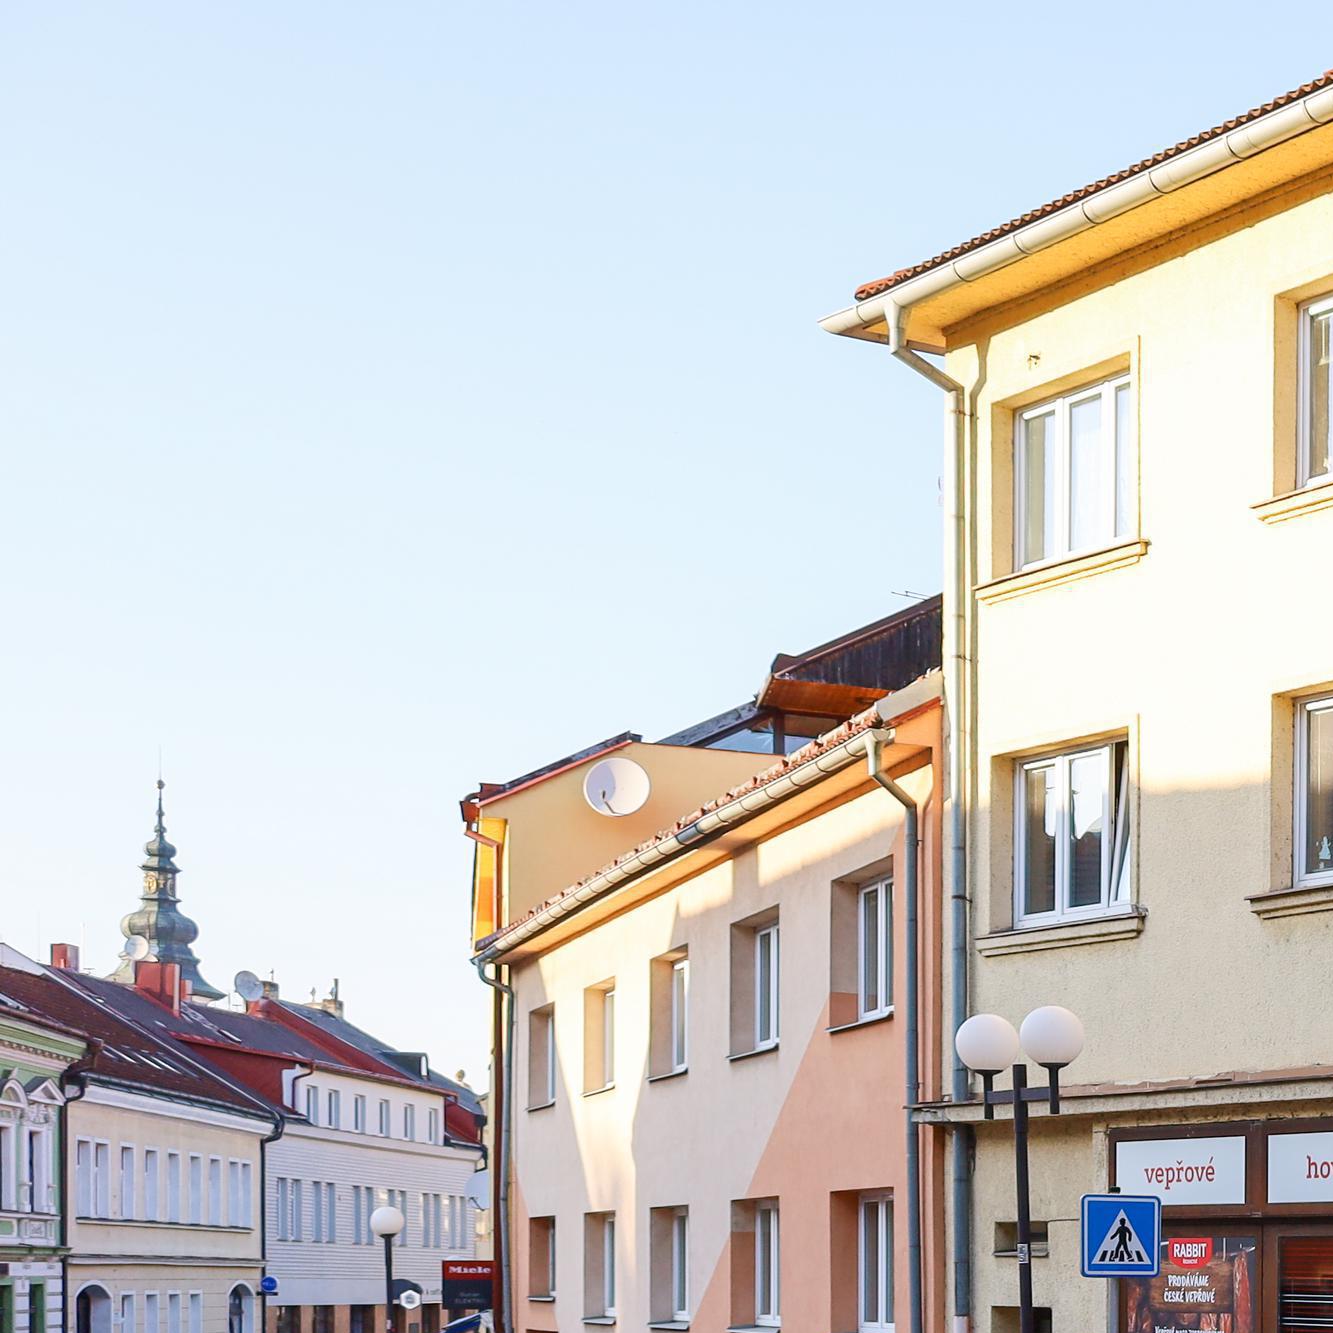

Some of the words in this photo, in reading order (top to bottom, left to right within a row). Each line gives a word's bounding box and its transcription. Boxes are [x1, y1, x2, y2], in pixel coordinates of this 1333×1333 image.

[1144, 1157, 1216, 1190] vepřové
[1174, 1243, 1207, 1257] RABBIT
[1168, 1272, 1209, 1286] PRODÁVÁME
[1164, 1288, 1184, 1302] ČESKÉ
[1185, 1288, 1215, 1303] VEPŘOVÉ
